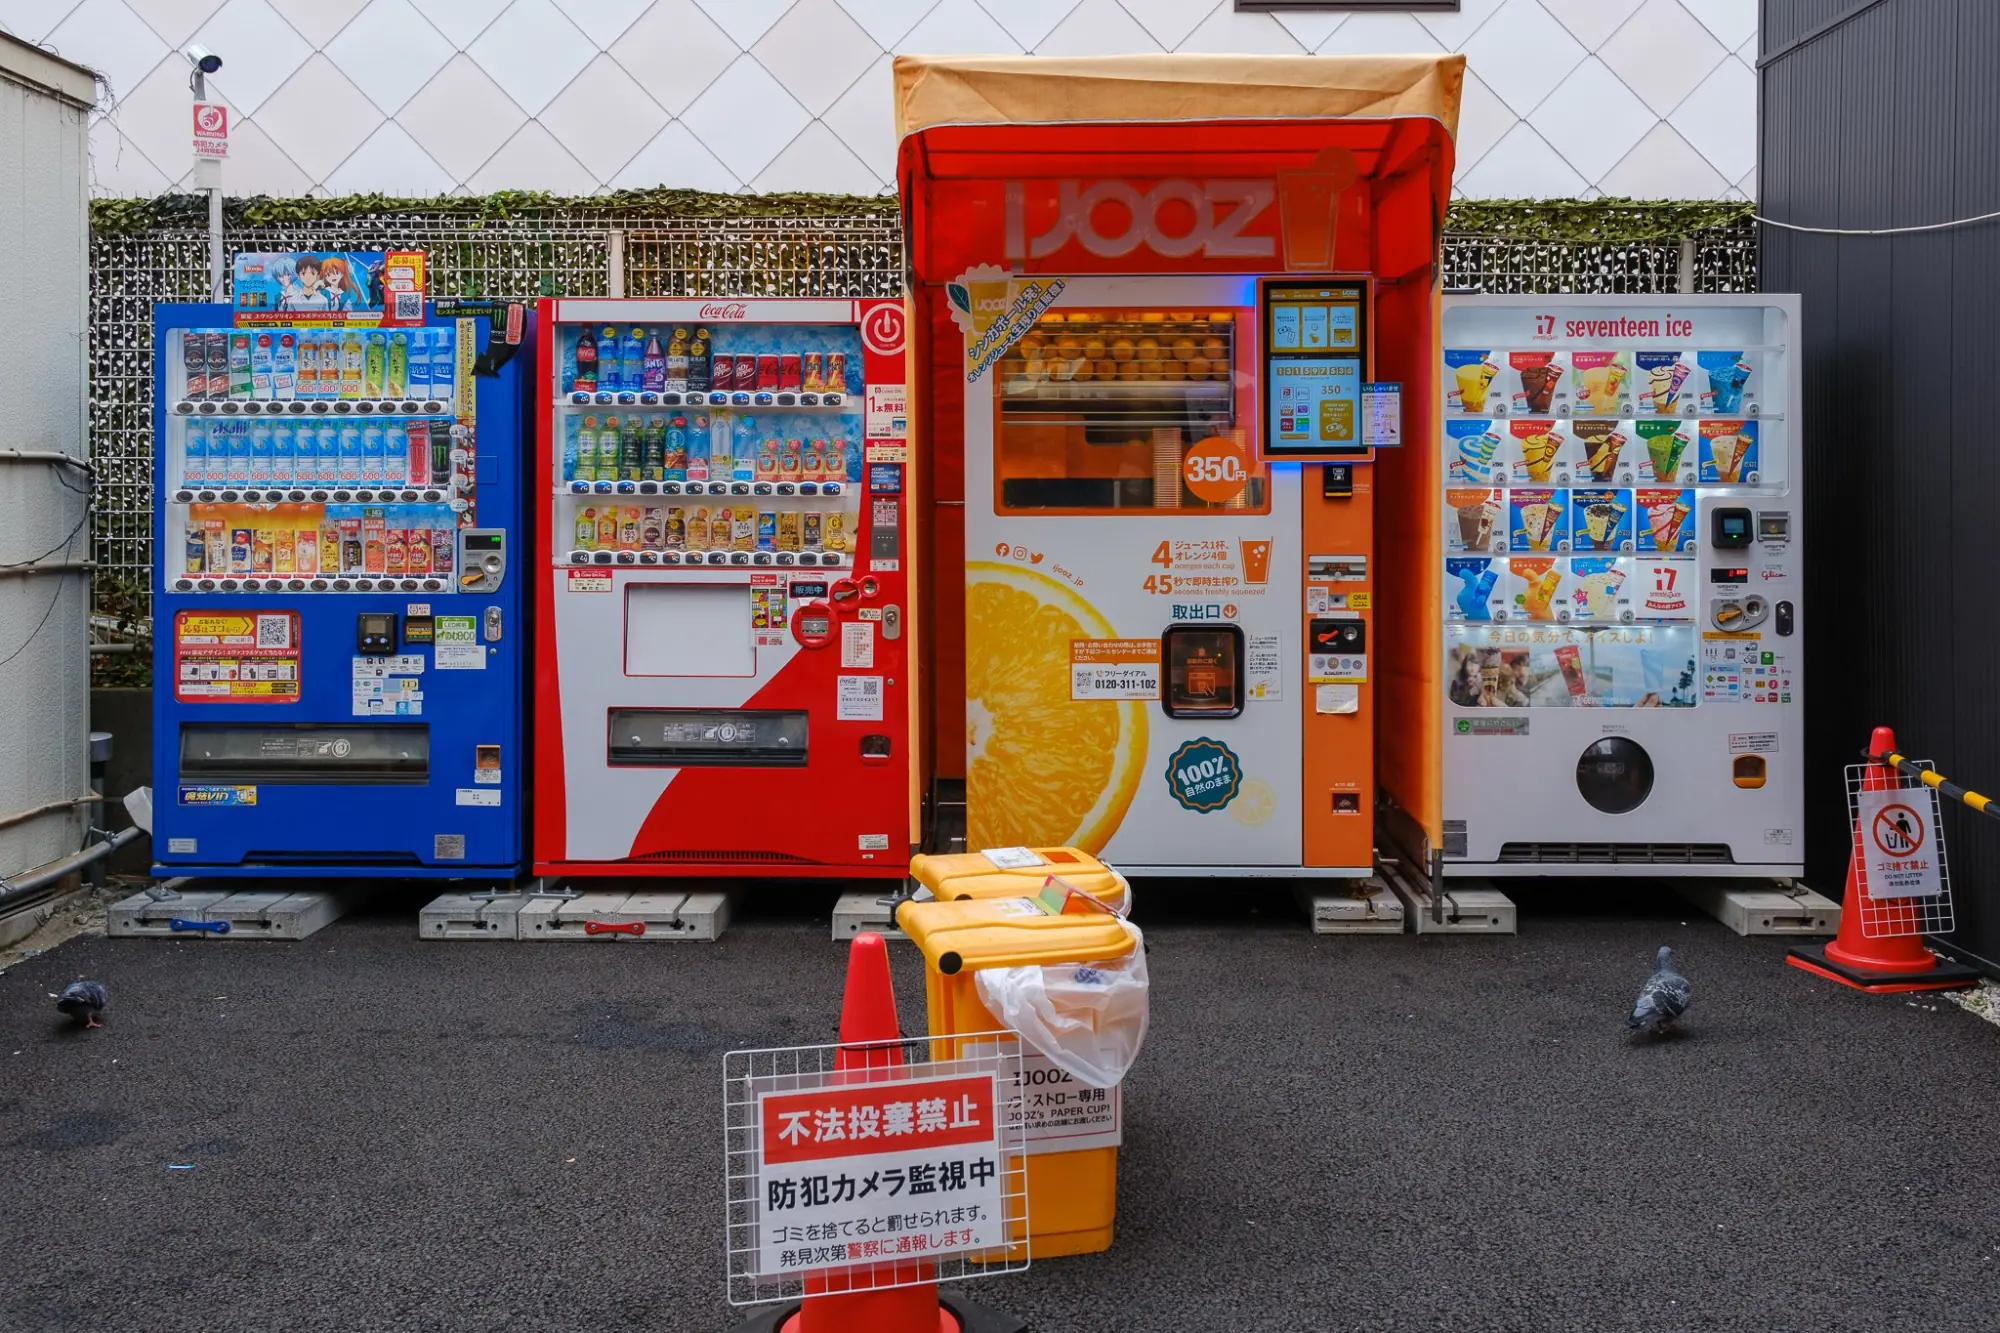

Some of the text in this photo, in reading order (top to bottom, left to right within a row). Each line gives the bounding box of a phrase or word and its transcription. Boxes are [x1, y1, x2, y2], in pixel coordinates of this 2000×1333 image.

[1005, 180, 1275, 260] IJOOZ
[700, 303, 748, 319] Coca-Cola
[968, 281, 1043, 360] シンガポール発!
[1565, 316, 1660, 337] seventeen
[1666, 313, 1693, 337] ice
[1321, 385, 1341, 394] 350
[213, 420, 247, 434] Asahi
[1187, 456, 1247, 482] 350円
[1151, 540, 1173, 568] 4
[1175, 551, 1227, 560] オレンジ4個
[1052, 563, 1084, 586] ijooz_jp
[1222, 563, 1236, 571] cup
[1761, 570, 1787, 580] Glico
[1143, 574, 1173, 595] 45
[1205, 588, 1229, 597] freshly
[1231, 588, 1266, 597] squeezed
[1172, 604, 1221, 619] 取出口
[1095, 679, 1156, 689] 0120-311-102
[1177, 755, 1229, 786] 100%
[1184, 773, 1232, 798] 自然のまま
[1877, 860, 1929, 871] ゴミ捨て禁止
[778, 1094, 980, 1146] 不法投棄禁止
[1051, 1108, 1084, 1117] PAPER
[1087, 1104, 1110, 1114] CUP!
[768, 1156, 996, 1213] 防犯カメラ監視中
[772, 1204, 988, 1245] ゴミを捨てると罰せられます。
[780, 1227, 981, 1268] 発見次第警察に通報します。
